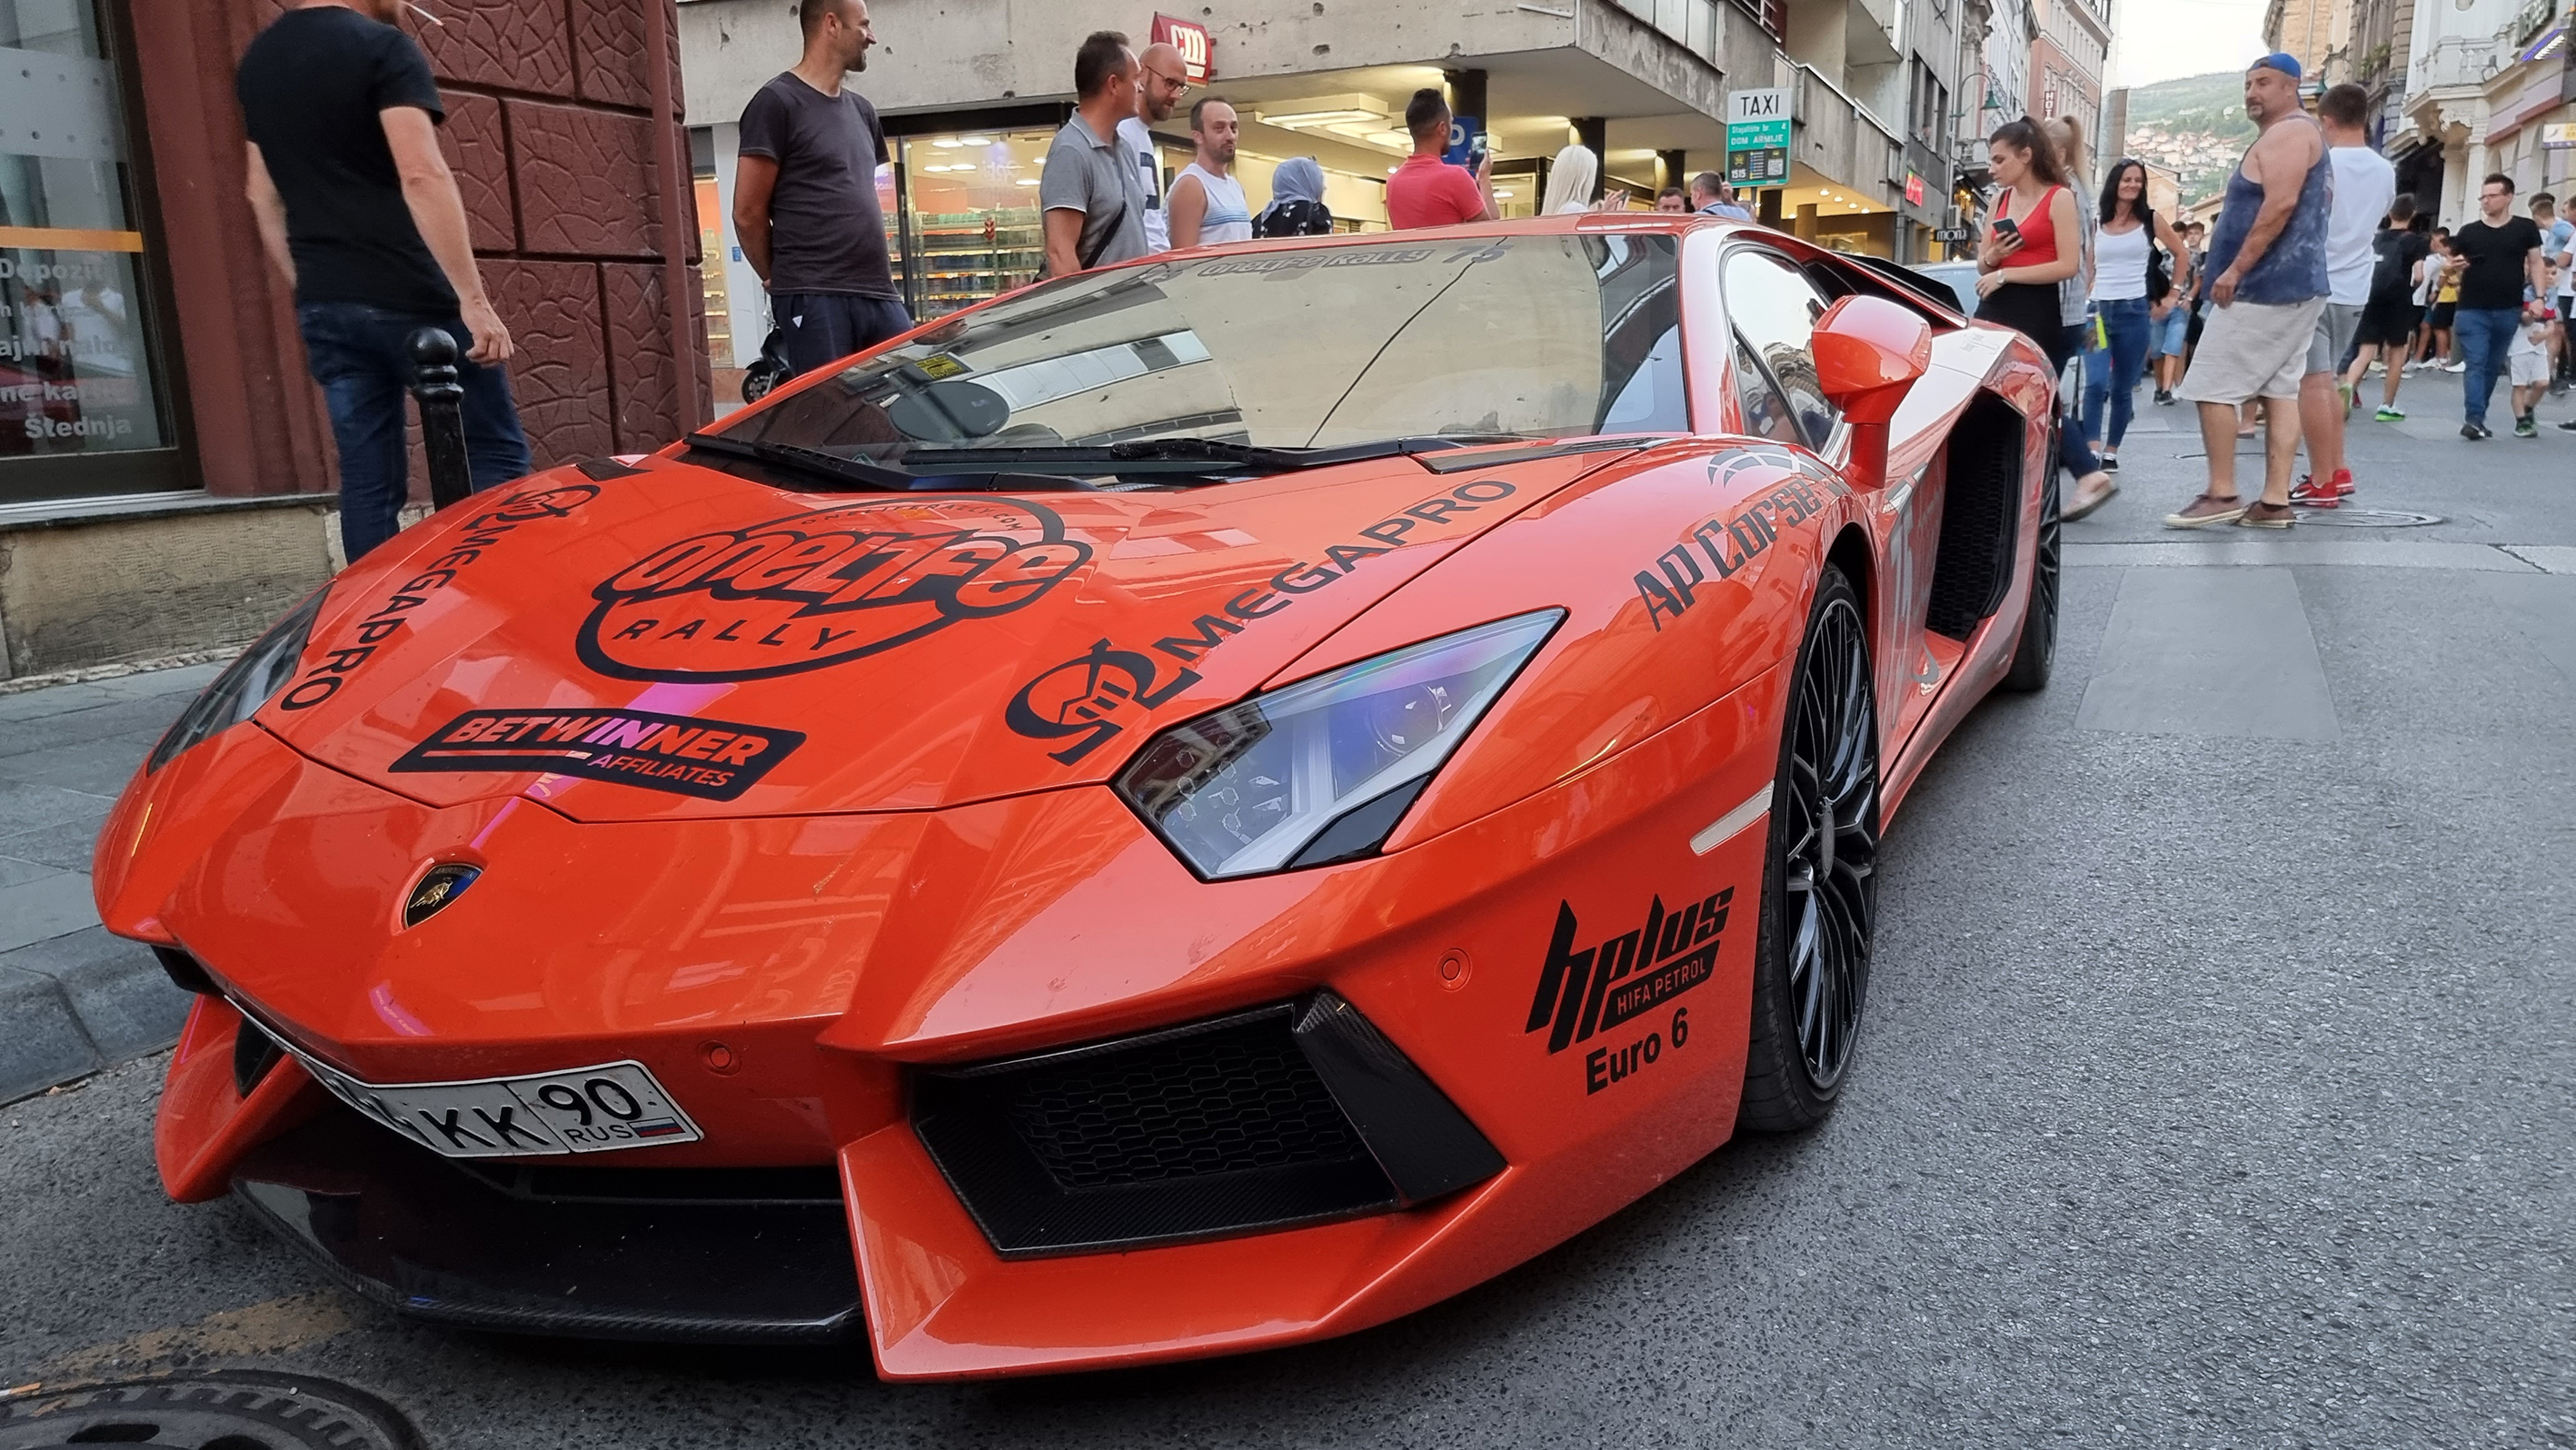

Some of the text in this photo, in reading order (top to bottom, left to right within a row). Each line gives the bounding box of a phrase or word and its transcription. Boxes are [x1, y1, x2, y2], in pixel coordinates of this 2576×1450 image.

[1740, 94, 1779, 116] TAXI
[1731, 134, 1784, 145] DOM ARMIJE
[1731, 168, 1746, 179] 1515
[1442, 244, 1514, 263] 75
[25, 413, 132, 440] Štednja
[612, 619, 857, 651] RALLY
[442, 717, 770, 767] BETWINNER
[586, 753, 736, 787] AFFILIATES
[1525, 885, 1736, 1056] hplus
[1616, 958, 1706, 1016] HIFA PETROL
[1586, 1007, 1688, 1097] Euro 6
[538, 1078, 642, 1126] 90
[563, 1124, 633, 1144] RUS
